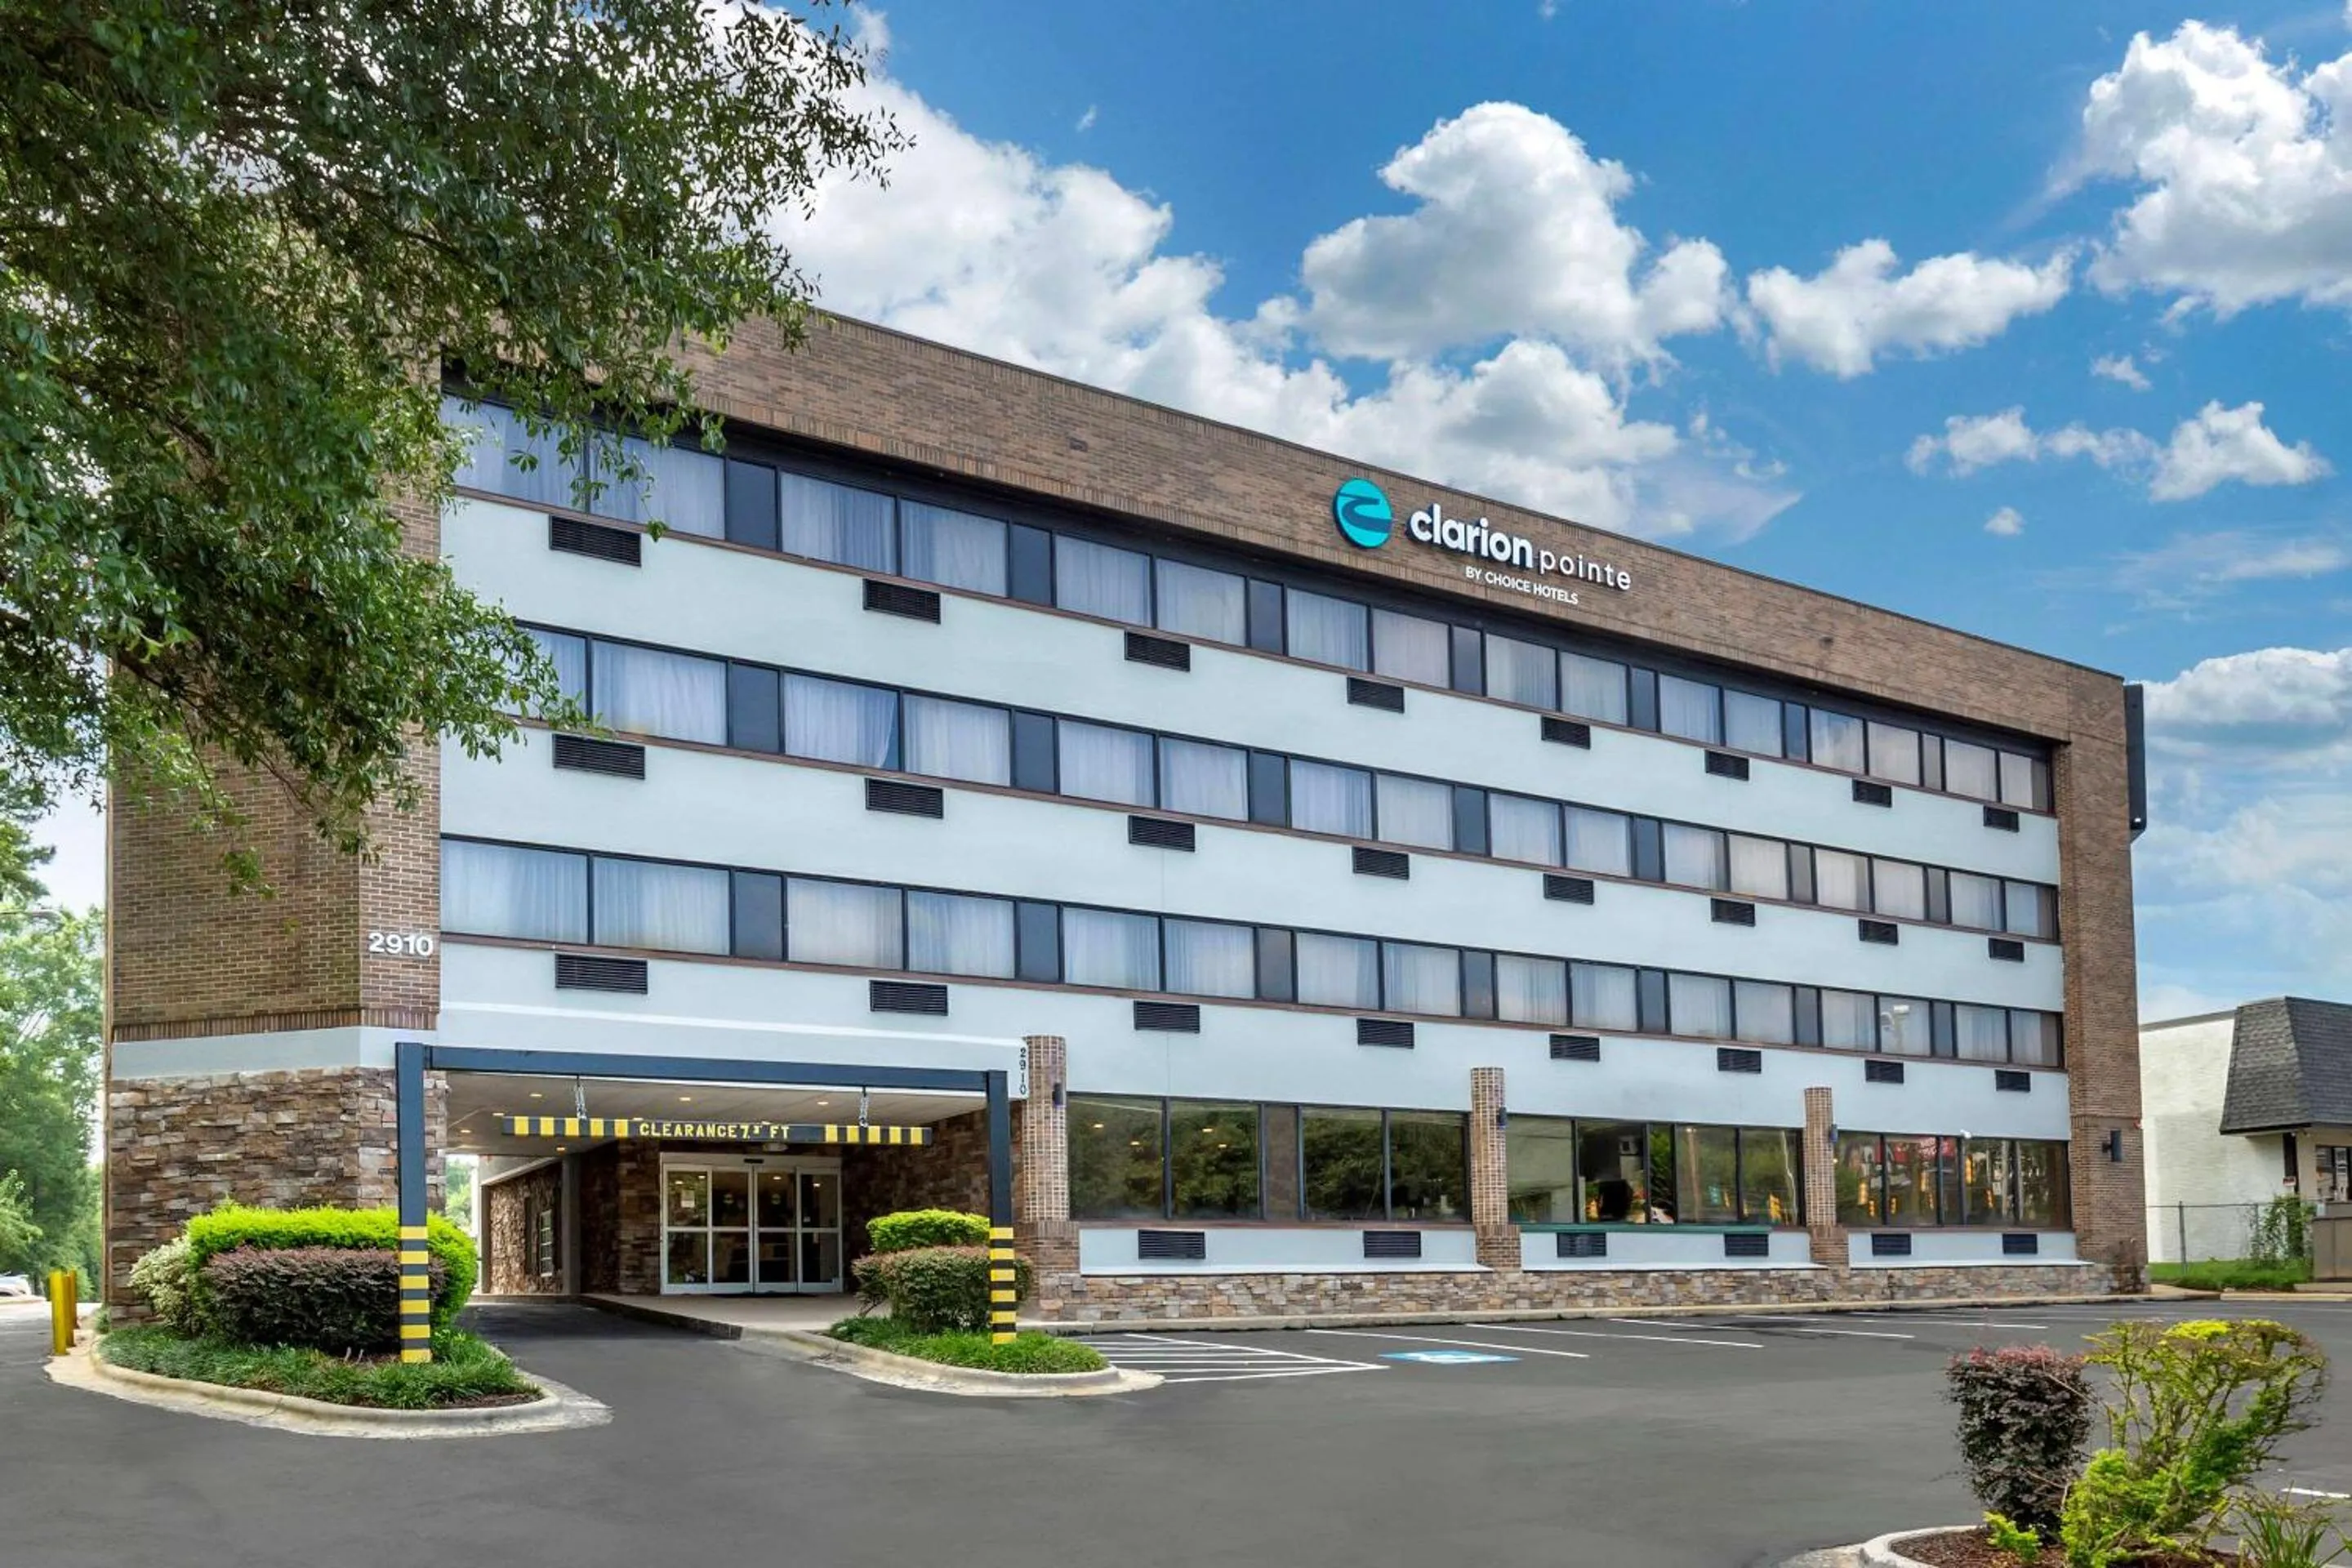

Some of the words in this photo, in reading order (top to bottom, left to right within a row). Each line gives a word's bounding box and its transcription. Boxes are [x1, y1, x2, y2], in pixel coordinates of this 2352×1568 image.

[1410, 503, 1534, 569] clarion
[1539, 549, 1632, 590] pointe
[1465, 565, 1482, 581] BY
[1485, 570, 1531, 594] CHOICE
[1533, 582, 1579, 606] HOTELS
[368, 932, 434, 957] 2910
[1018, 1046, 1027, 1095] 2910
[639, 1122, 737, 1138] CLEARANCE
[770, 1125, 790, 1139] FT
